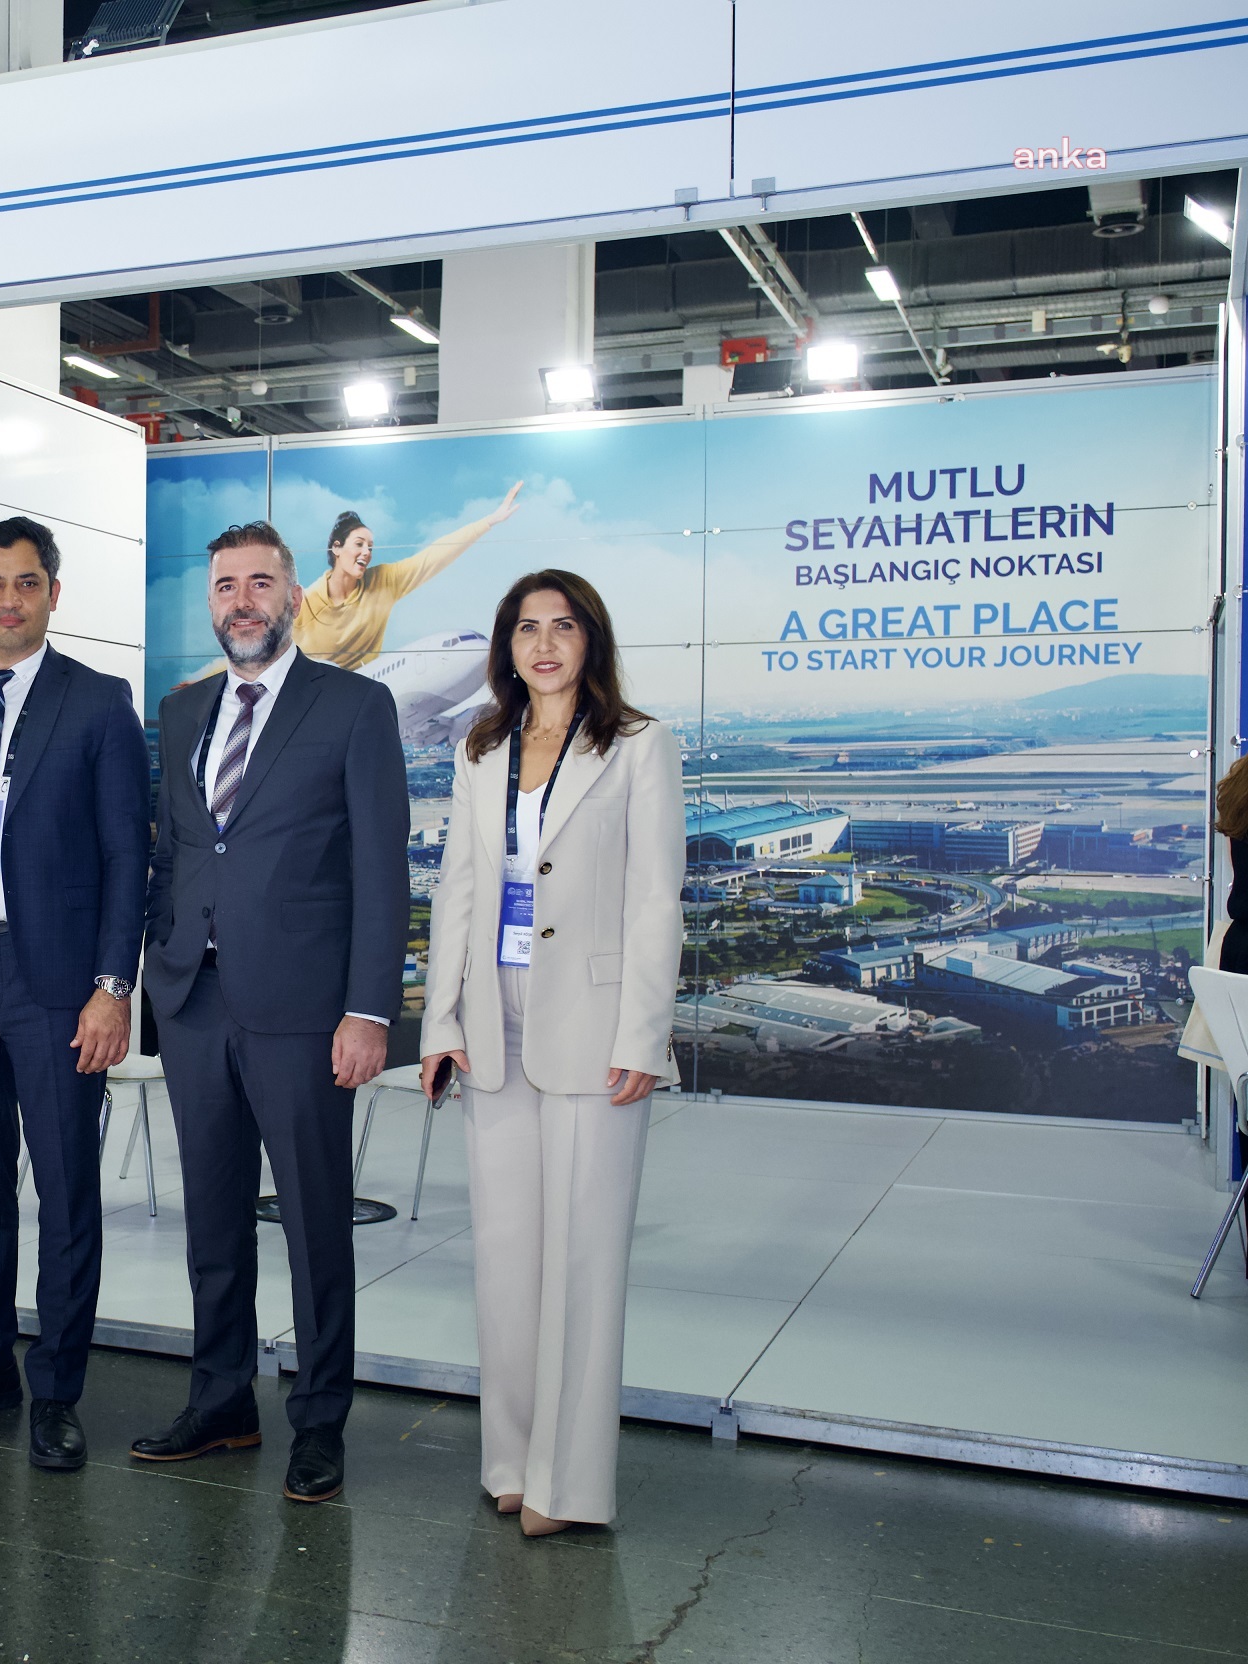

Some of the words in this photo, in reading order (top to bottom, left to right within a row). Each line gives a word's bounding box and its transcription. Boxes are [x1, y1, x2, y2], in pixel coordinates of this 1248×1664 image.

[868, 463, 1026, 504] MUTLU
[795, 559, 961, 590] BAŞLANGIÇ
[970, 552, 1103, 579] NOKTASI
[779, 610, 808, 642] A
[818, 603, 961, 640] GREAT
[973, 598, 1119, 635] PLACE
[762, 650, 799, 672] TO
[806, 648, 898, 671] START
[903, 646, 986, 669] YOUR
[994, 642, 1143, 667] JOURNEY
